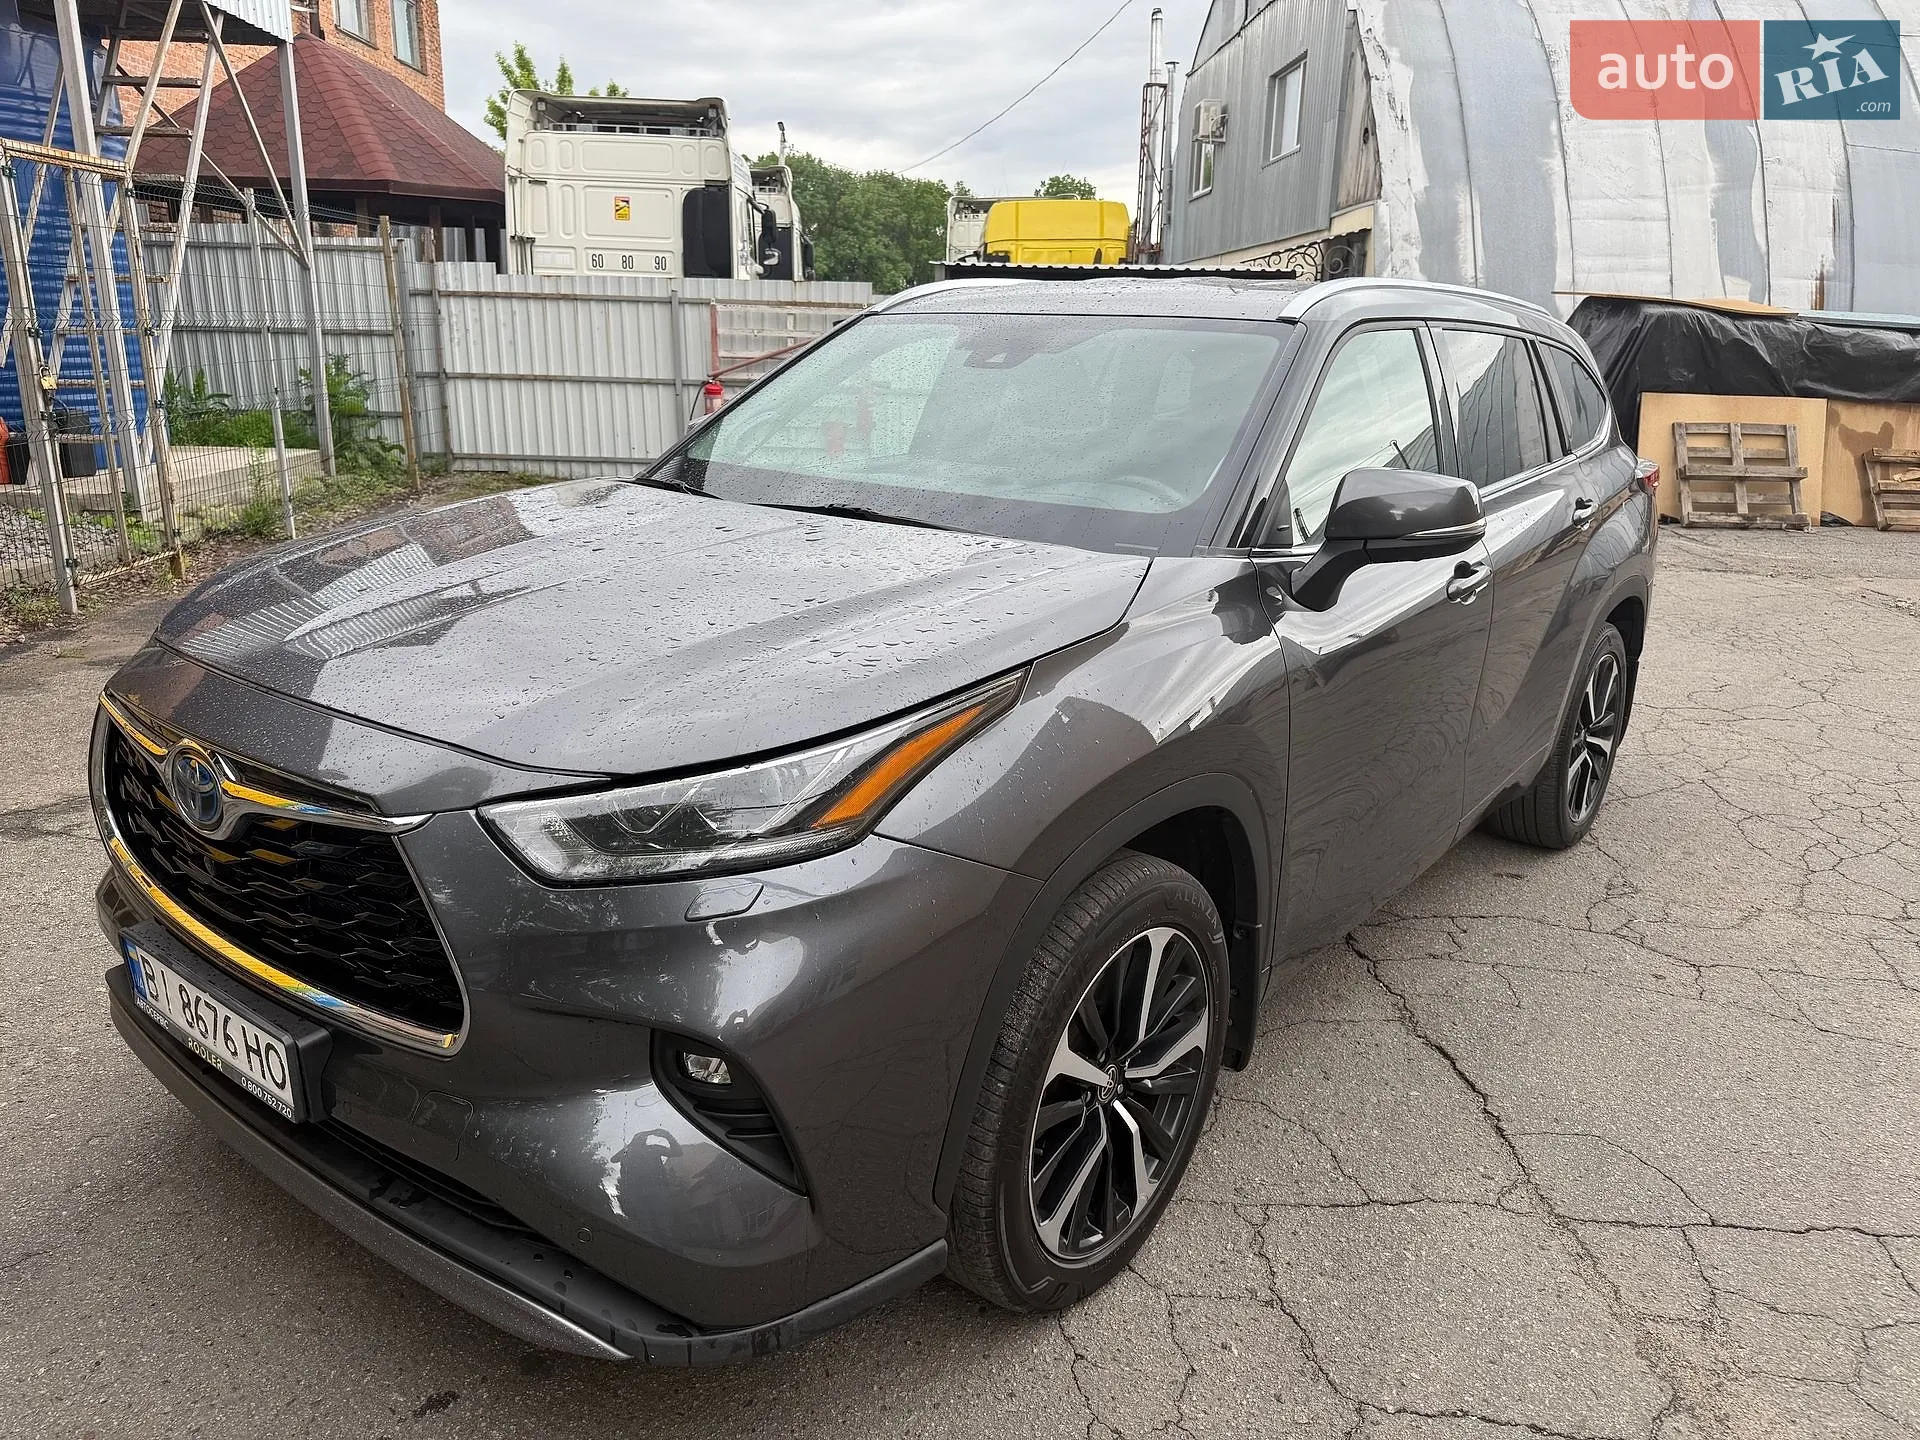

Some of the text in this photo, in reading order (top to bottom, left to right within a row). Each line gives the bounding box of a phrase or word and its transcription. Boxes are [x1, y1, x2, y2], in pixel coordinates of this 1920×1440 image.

[591, 253, 667, 271] 60 80 90
[140, 954, 287, 1090] BI 8676 HO
[247, 1080, 263, 1098] 800
[262, 1091, 277, 1109] 752
[277, 1100, 292, 1118] 720
